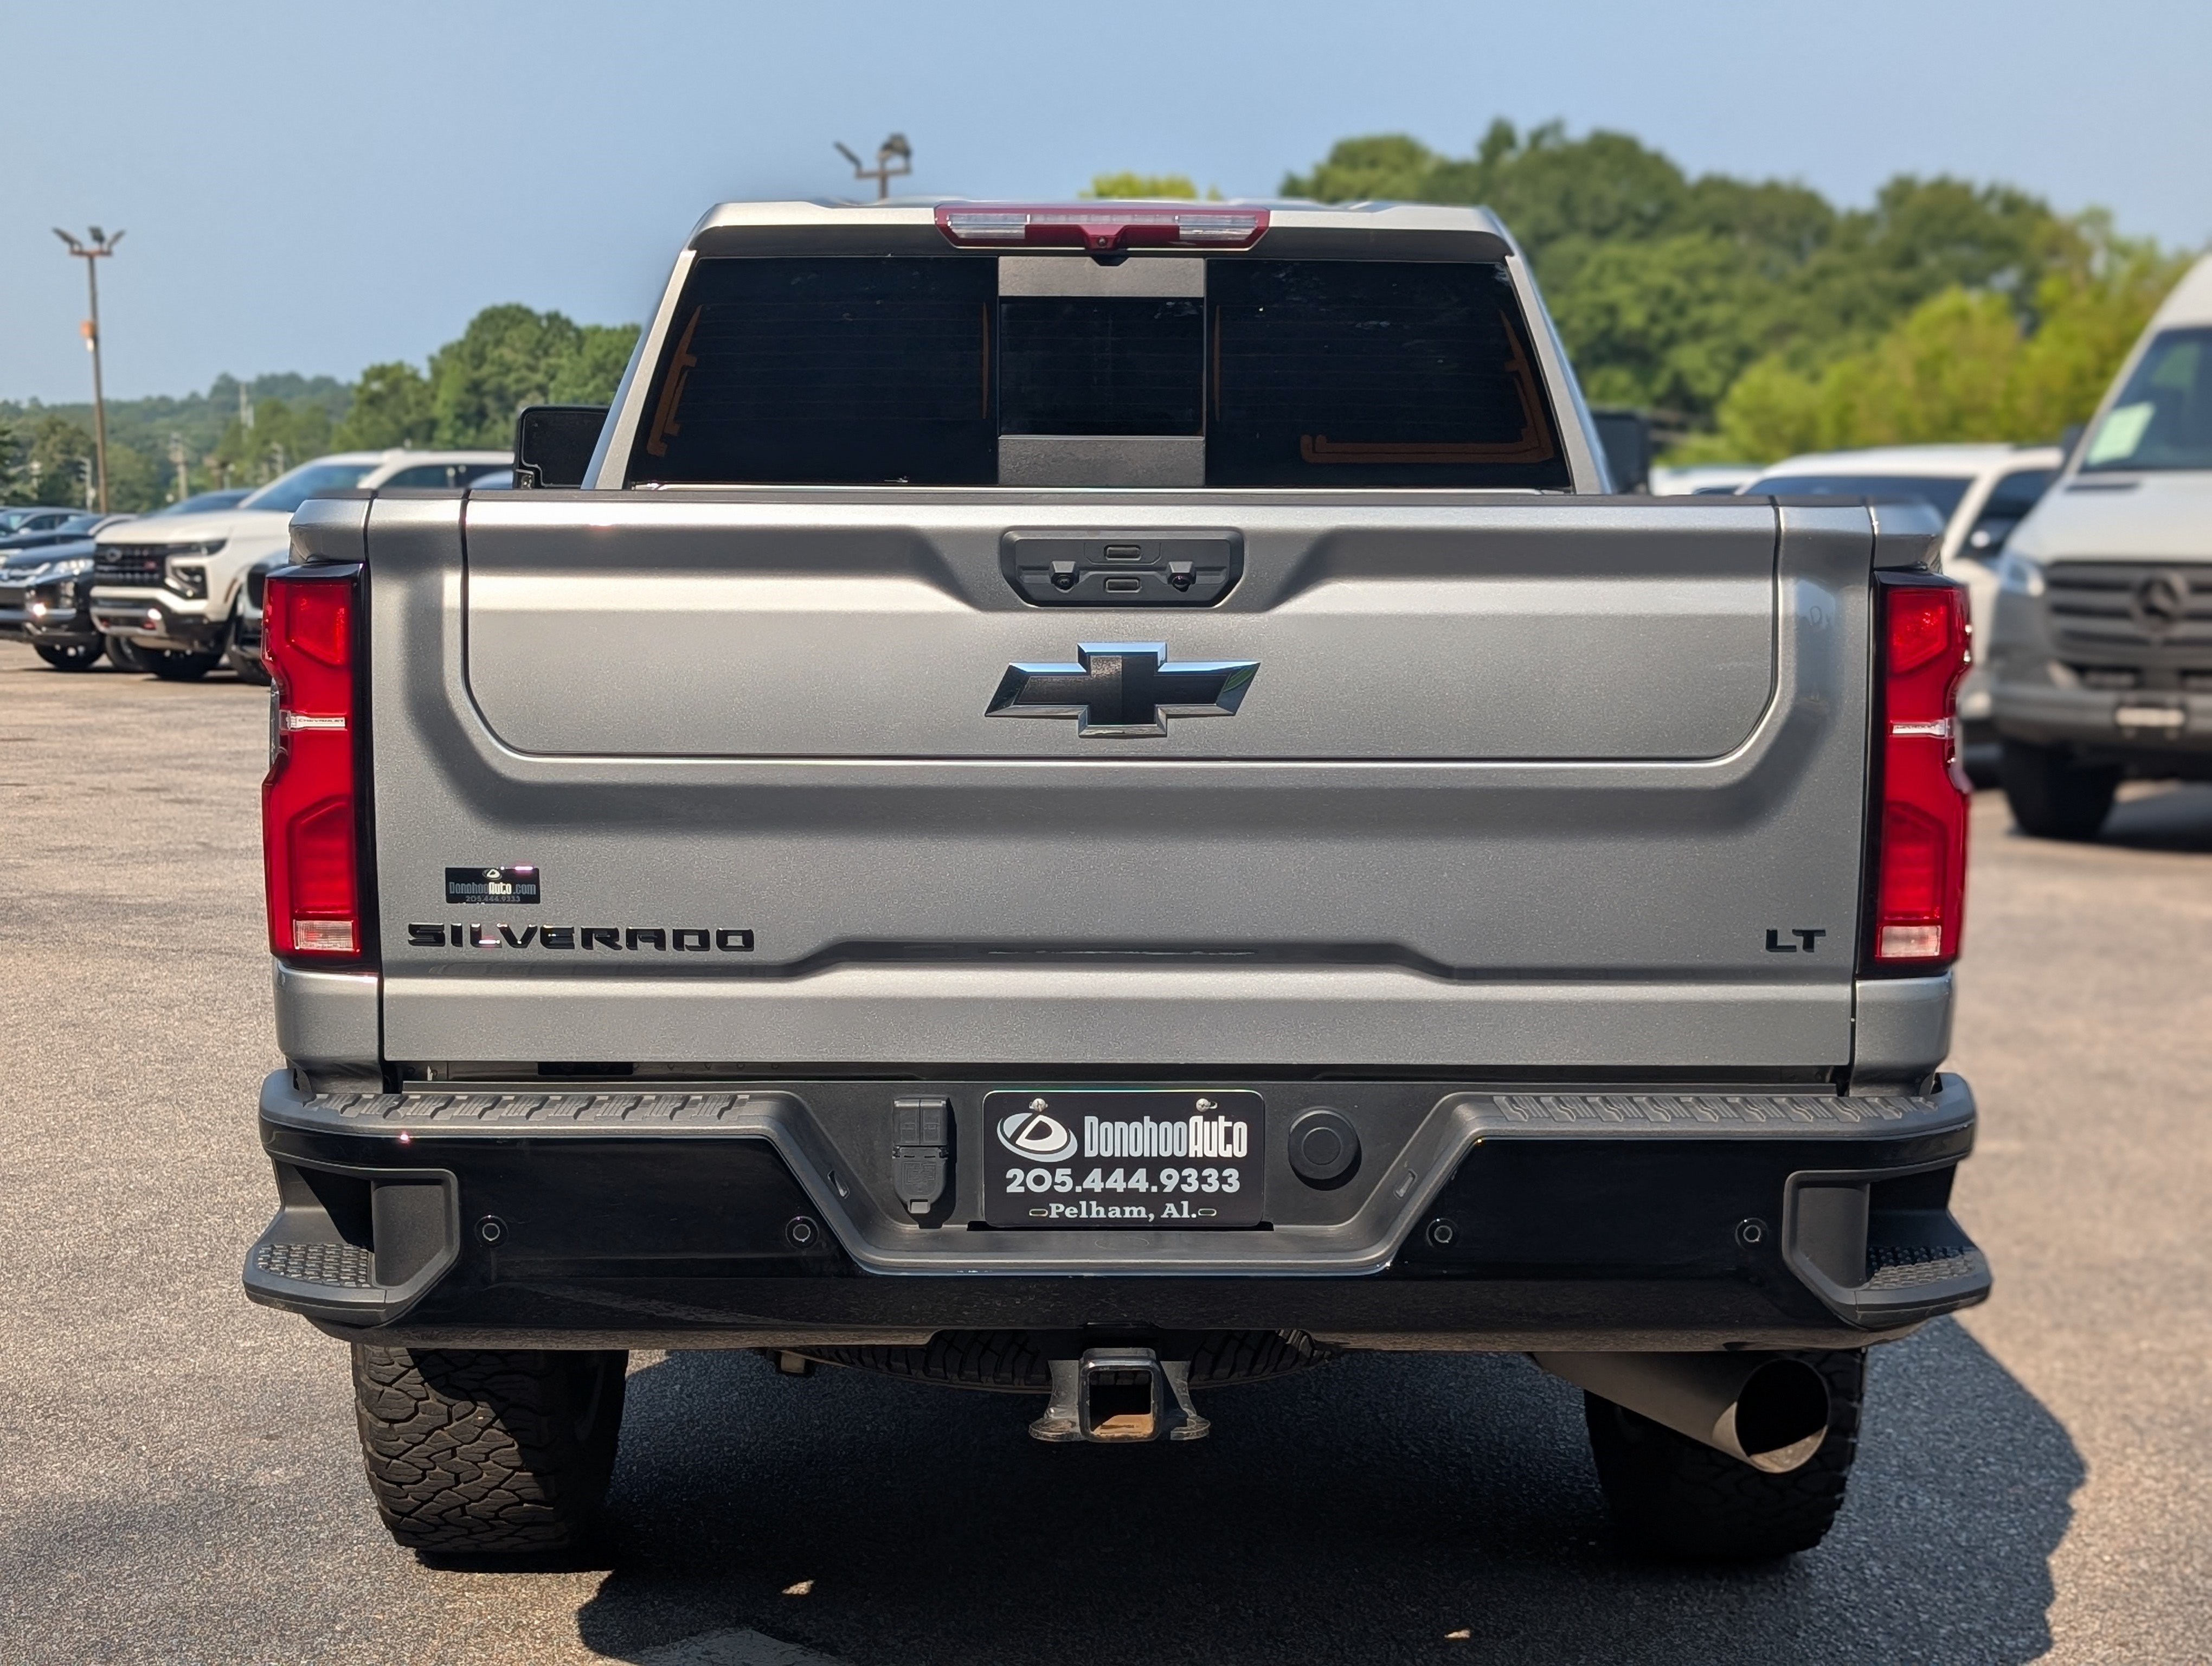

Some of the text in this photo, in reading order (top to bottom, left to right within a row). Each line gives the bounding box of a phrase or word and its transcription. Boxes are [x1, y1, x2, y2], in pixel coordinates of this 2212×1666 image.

[408, 922, 755, 952] SILVERADO
[1765, 928, 1827, 953] LT
[1084, 1116, 1248, 1158] DonohooAuto
[1006, 1168, 1240, 1193] 205.444.9333
[1049, 1201, 1197, 1222] Pelham, Al.
